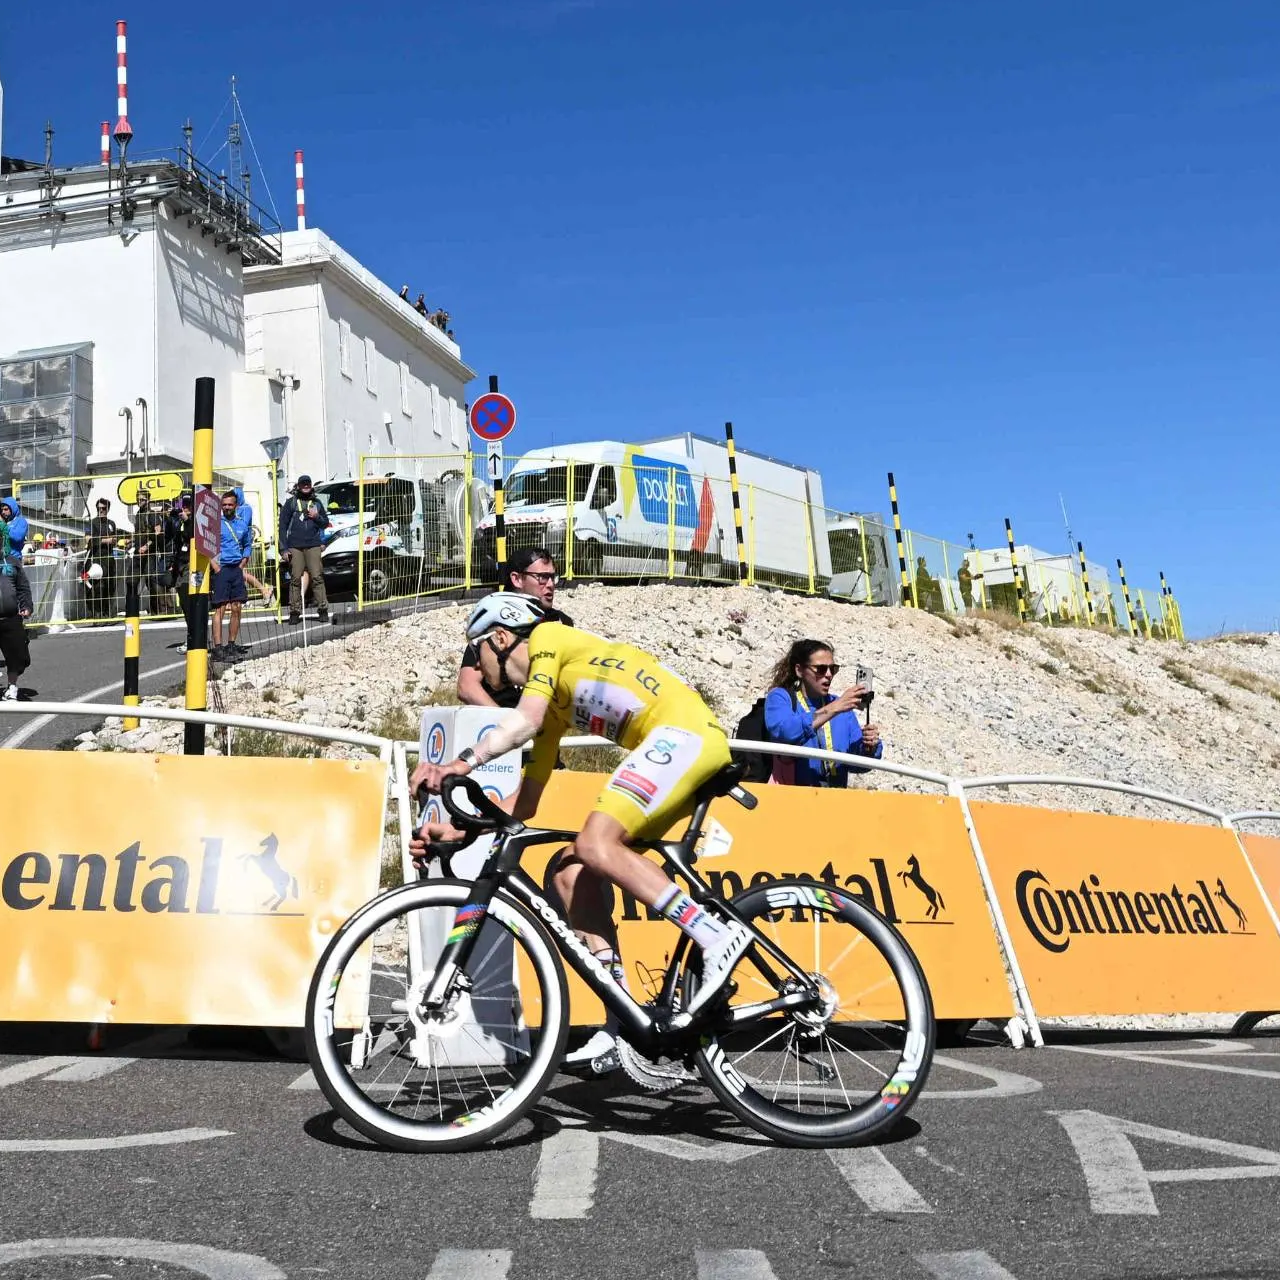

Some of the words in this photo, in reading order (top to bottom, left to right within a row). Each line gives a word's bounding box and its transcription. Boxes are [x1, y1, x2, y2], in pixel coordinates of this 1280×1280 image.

[139, 478, 166, 490] LCL
[588, 656, 625, 671] LCL
[636, 669, 662, 696] LCL
[645, 739, 677, 766] G42
[476, 763, 514, 774] Leclerc
[1015, 869, 1229, 955] Continental
